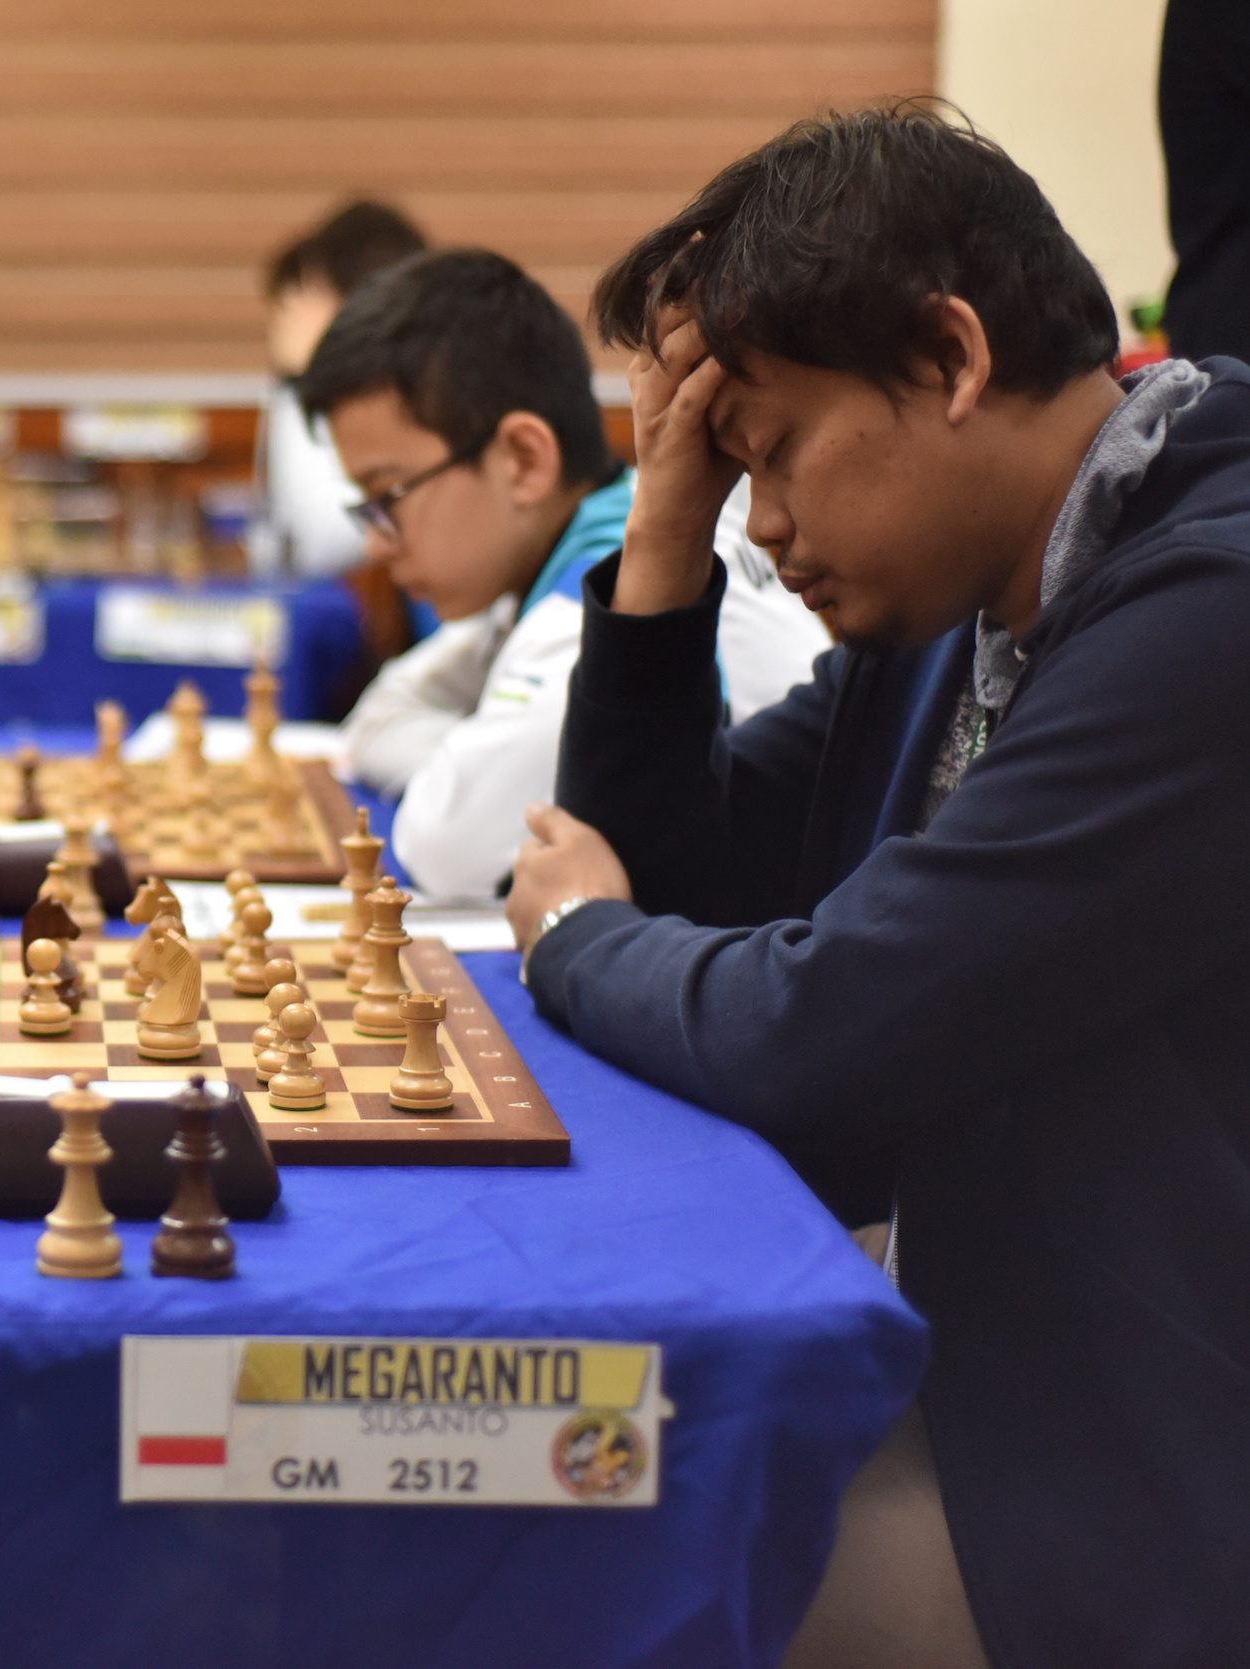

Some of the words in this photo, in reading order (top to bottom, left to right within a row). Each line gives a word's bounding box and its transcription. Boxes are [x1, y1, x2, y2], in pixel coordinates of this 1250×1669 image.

[493, 1075, 517, 1083] B
[507, 1101, 532, 1109] A
[303, 1345, 581, 1402] MEGARANTO
[359, 1407, 508, 1437] SUSANTO
[271, 1457, 340, 1490] GM
[388, 1459, 478, 1491] 2512
